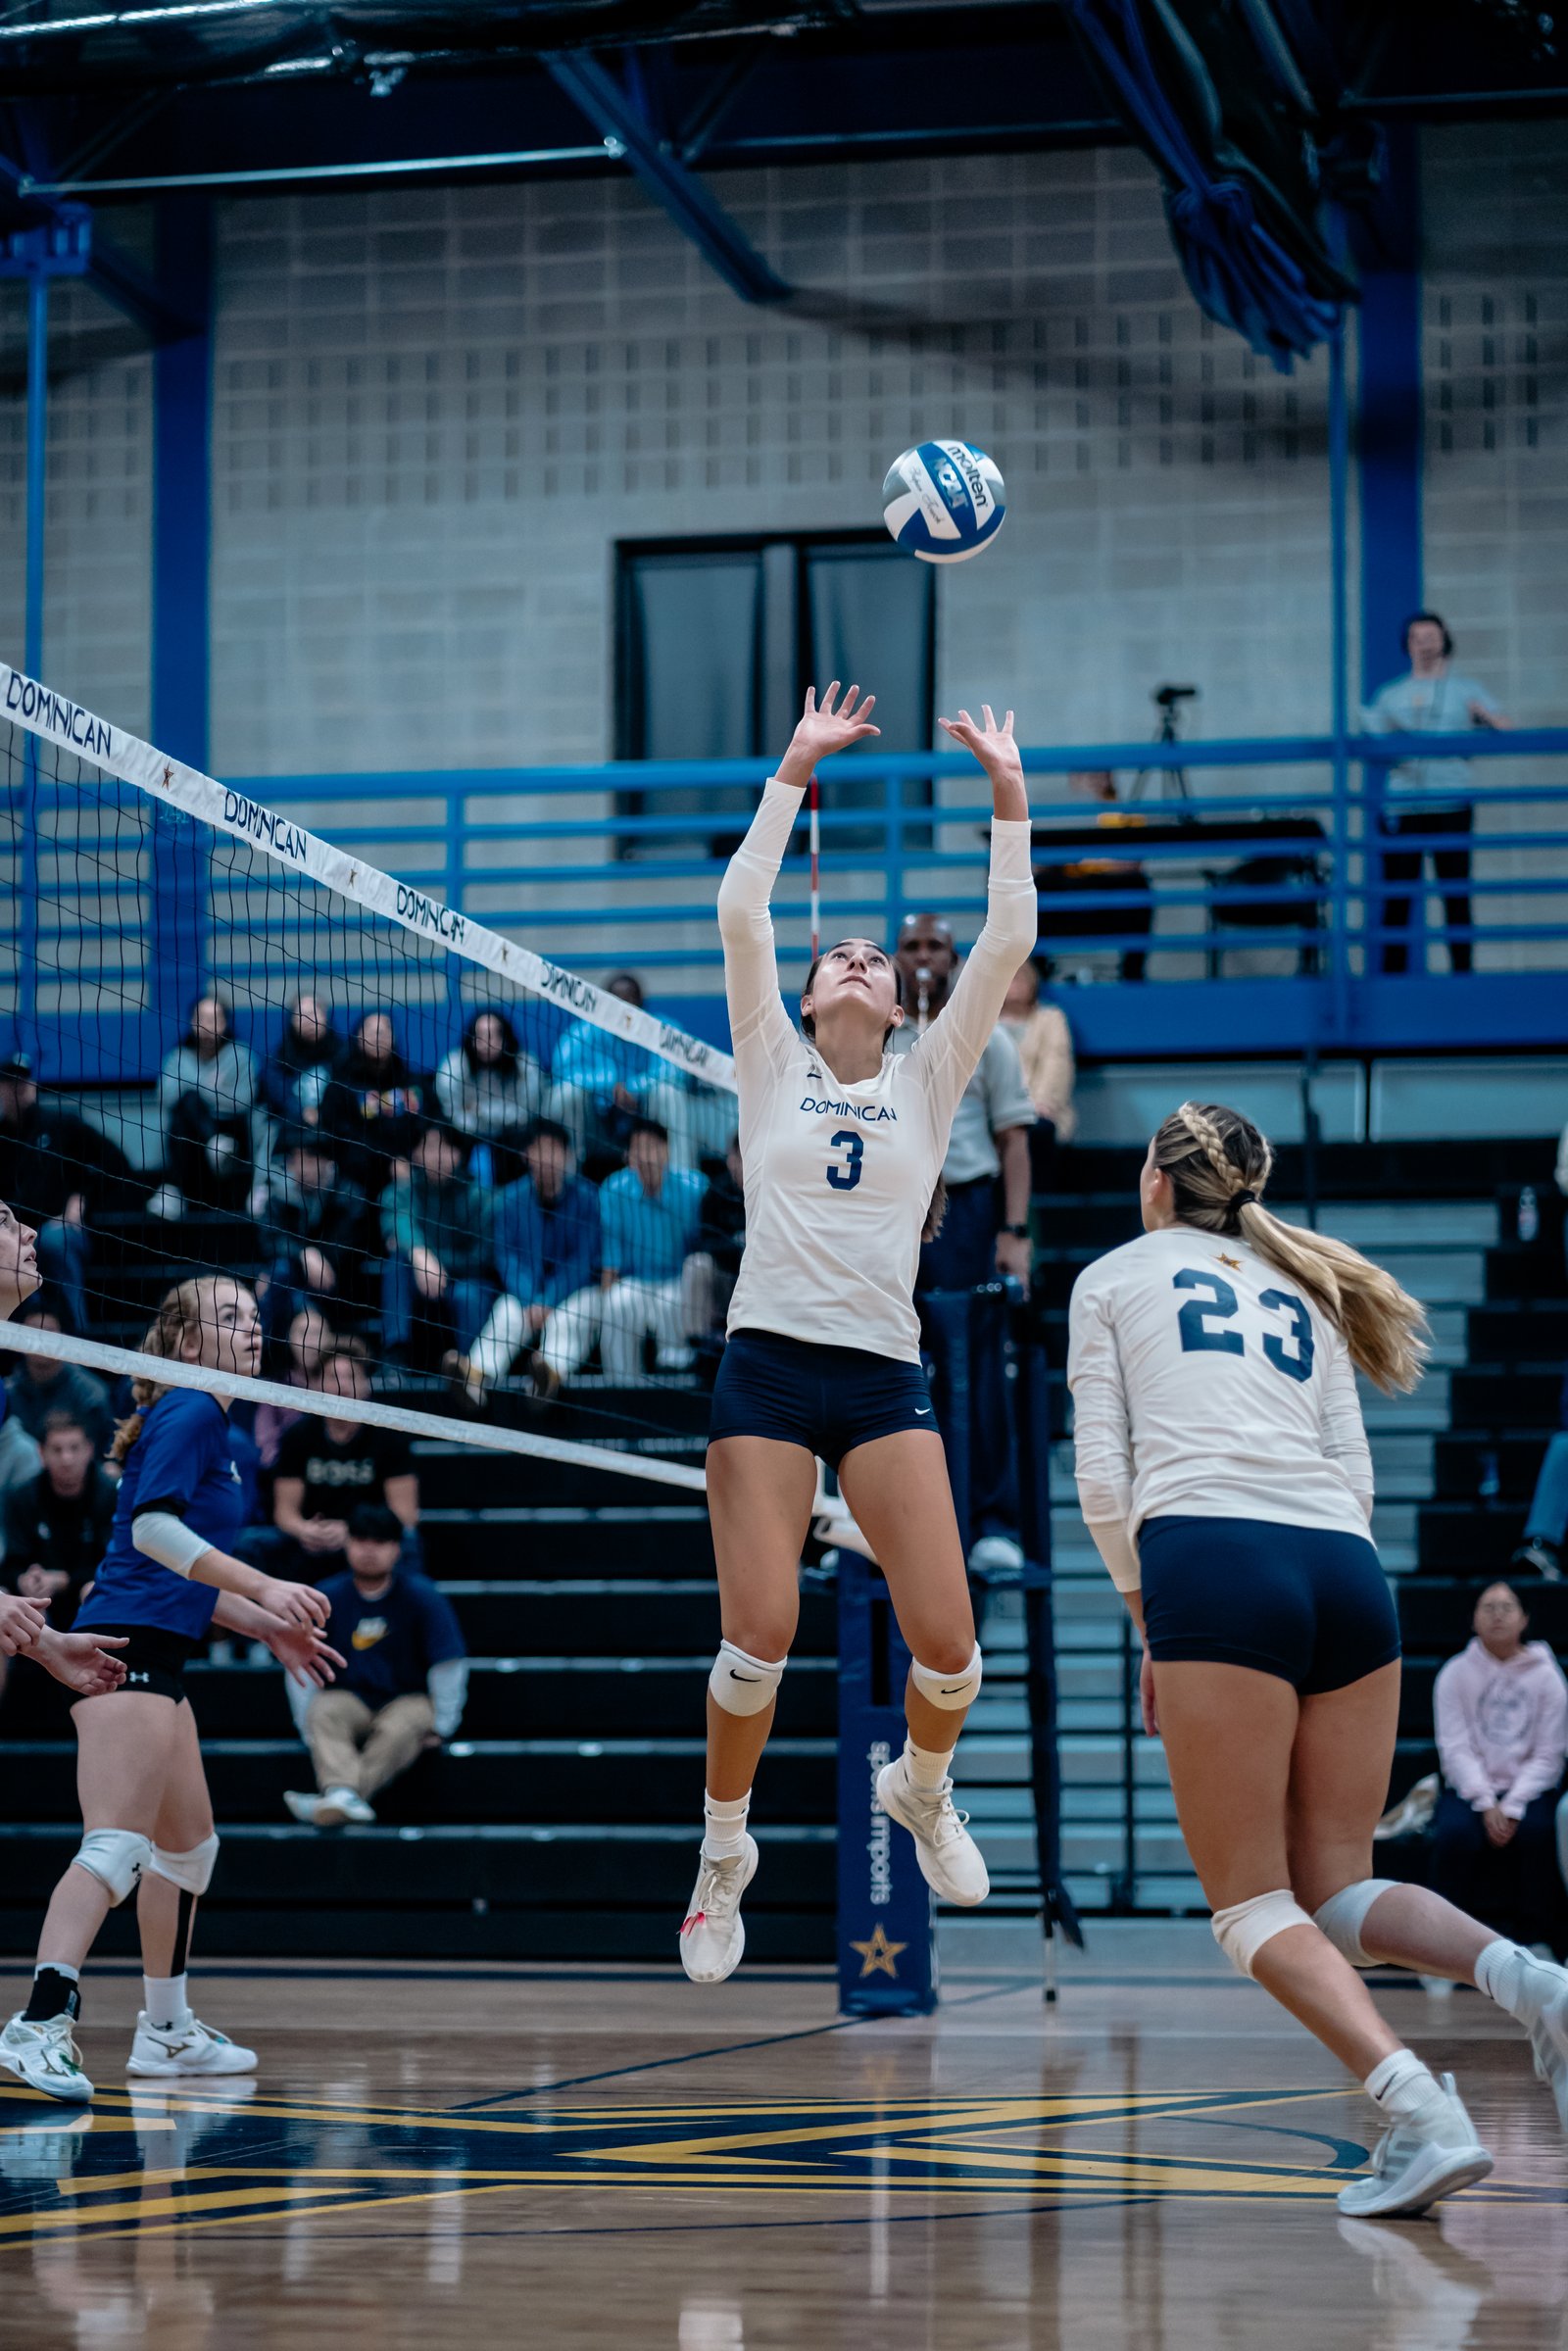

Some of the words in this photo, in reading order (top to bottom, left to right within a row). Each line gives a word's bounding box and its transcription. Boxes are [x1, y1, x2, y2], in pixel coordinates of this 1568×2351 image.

[948, 446, 987, 508] molten
[6, 670, 112, 759] DOMINICAN
[224, 788, 307, 863] DOMINICAN
[799, 1097, 898, 1121] DOMINICAN
[826, 1130, 864, 1192] 3
[1172, 1267, 1315, 1384] 23
[866, 1815, 893, 1905] imports
